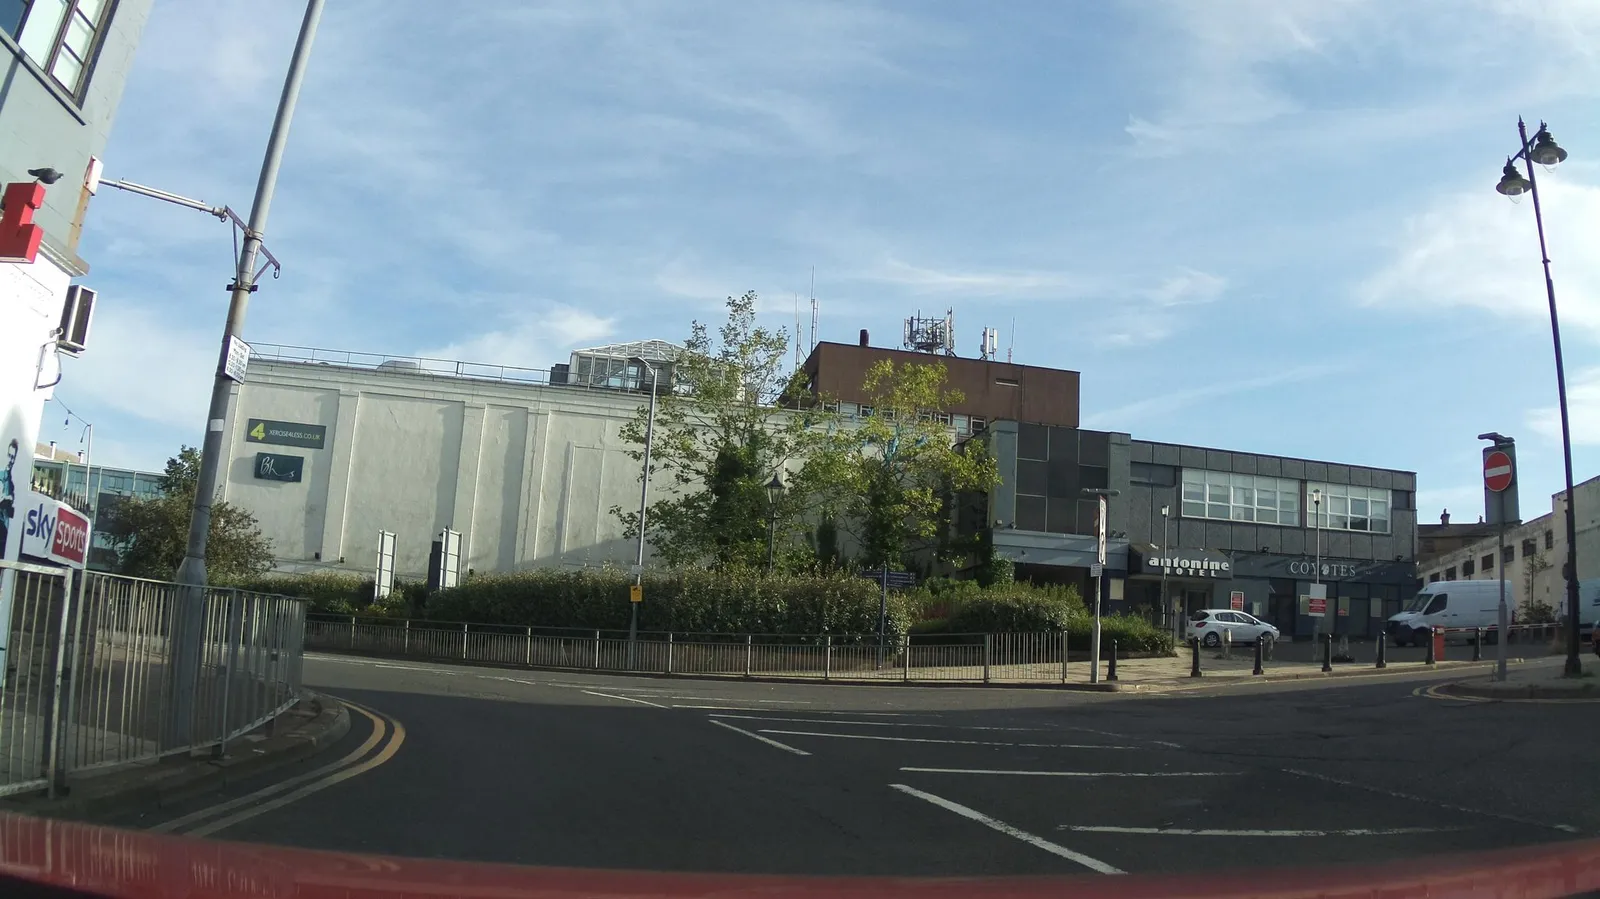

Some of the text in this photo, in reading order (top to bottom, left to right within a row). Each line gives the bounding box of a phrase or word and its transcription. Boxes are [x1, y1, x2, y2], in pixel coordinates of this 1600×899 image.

[250, 422, 265, 440] 4
[26, 503, 86, 553] sky sports
